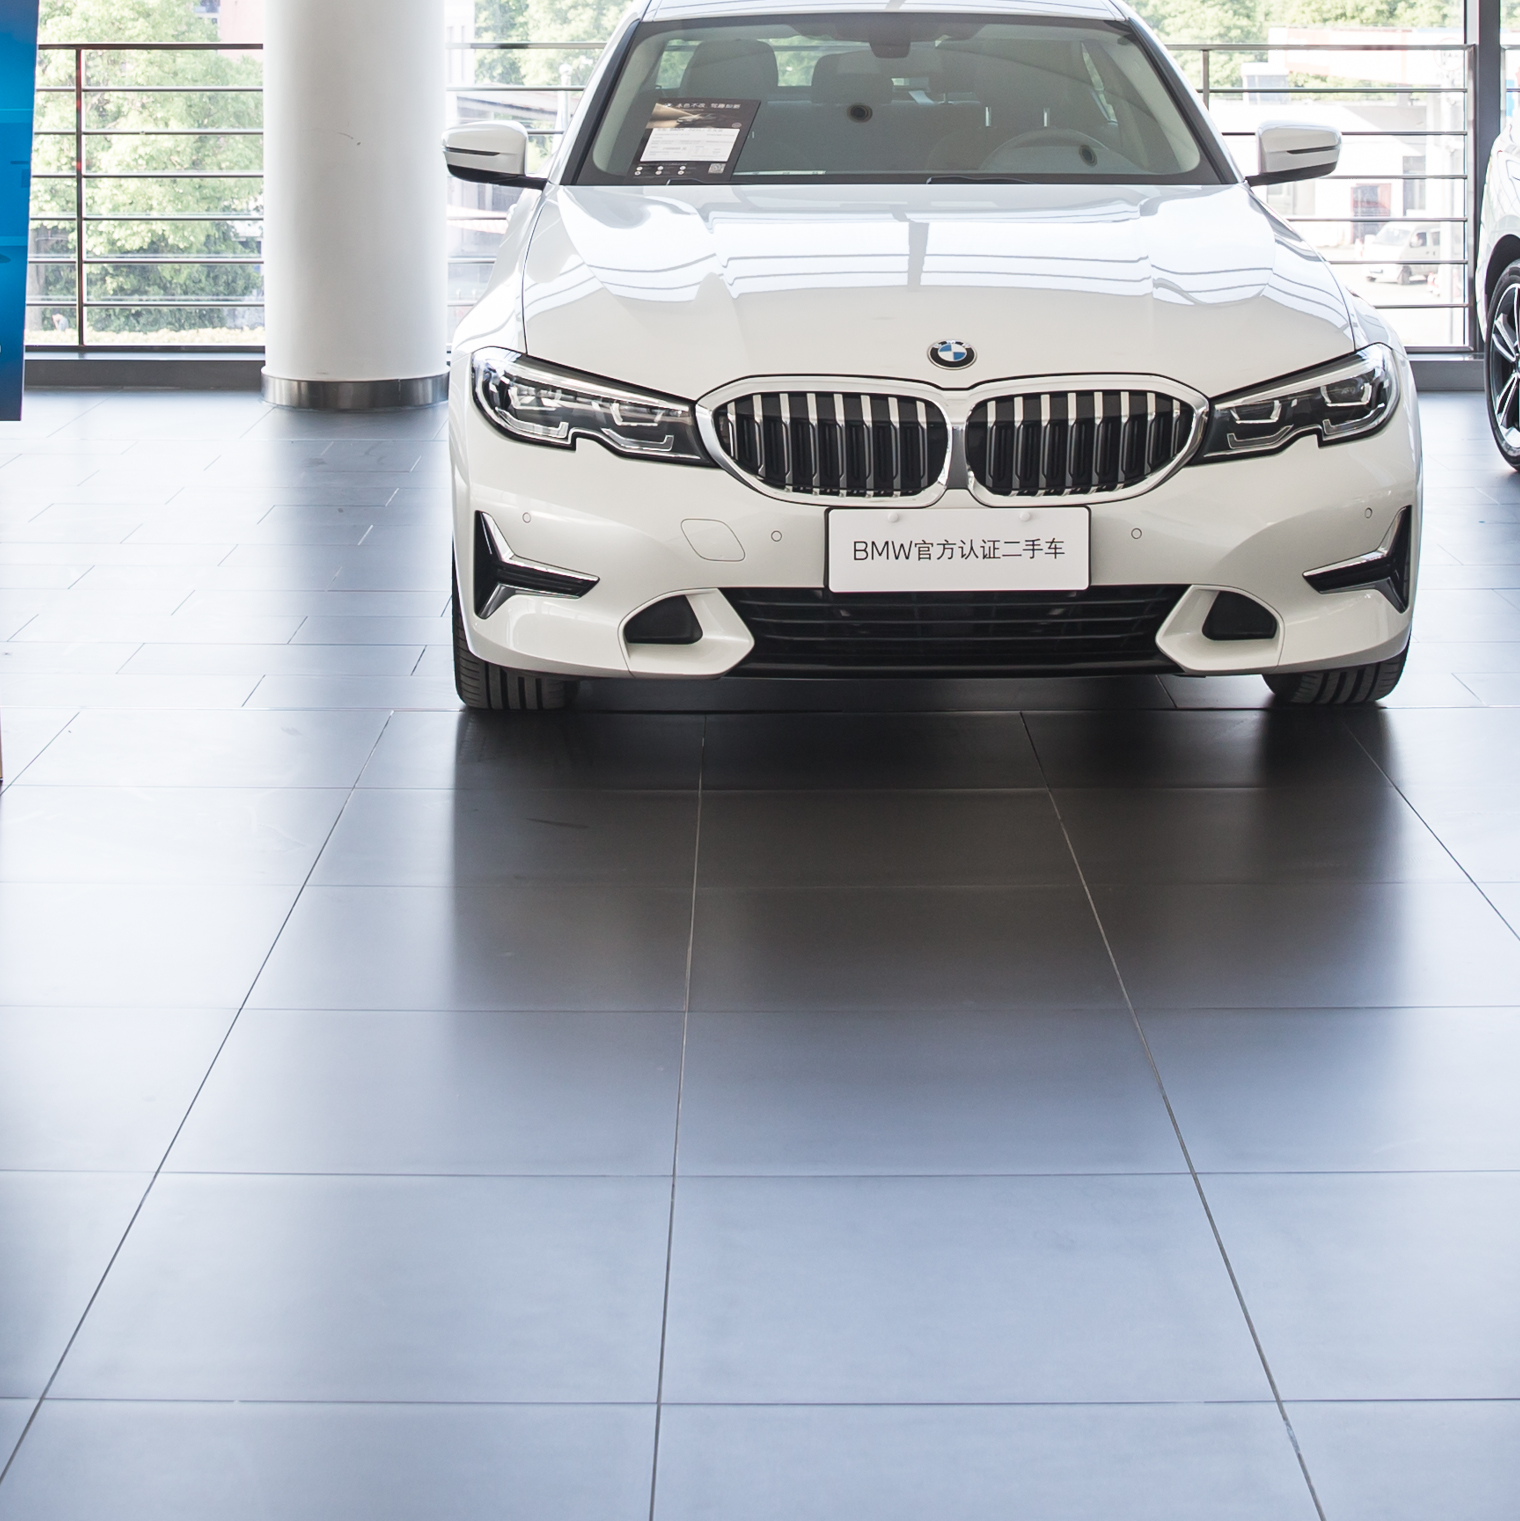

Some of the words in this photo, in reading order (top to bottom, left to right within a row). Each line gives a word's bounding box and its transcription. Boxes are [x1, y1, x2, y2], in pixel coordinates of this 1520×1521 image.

[852, 538, 1066, 562] BMW官方认证二手车
